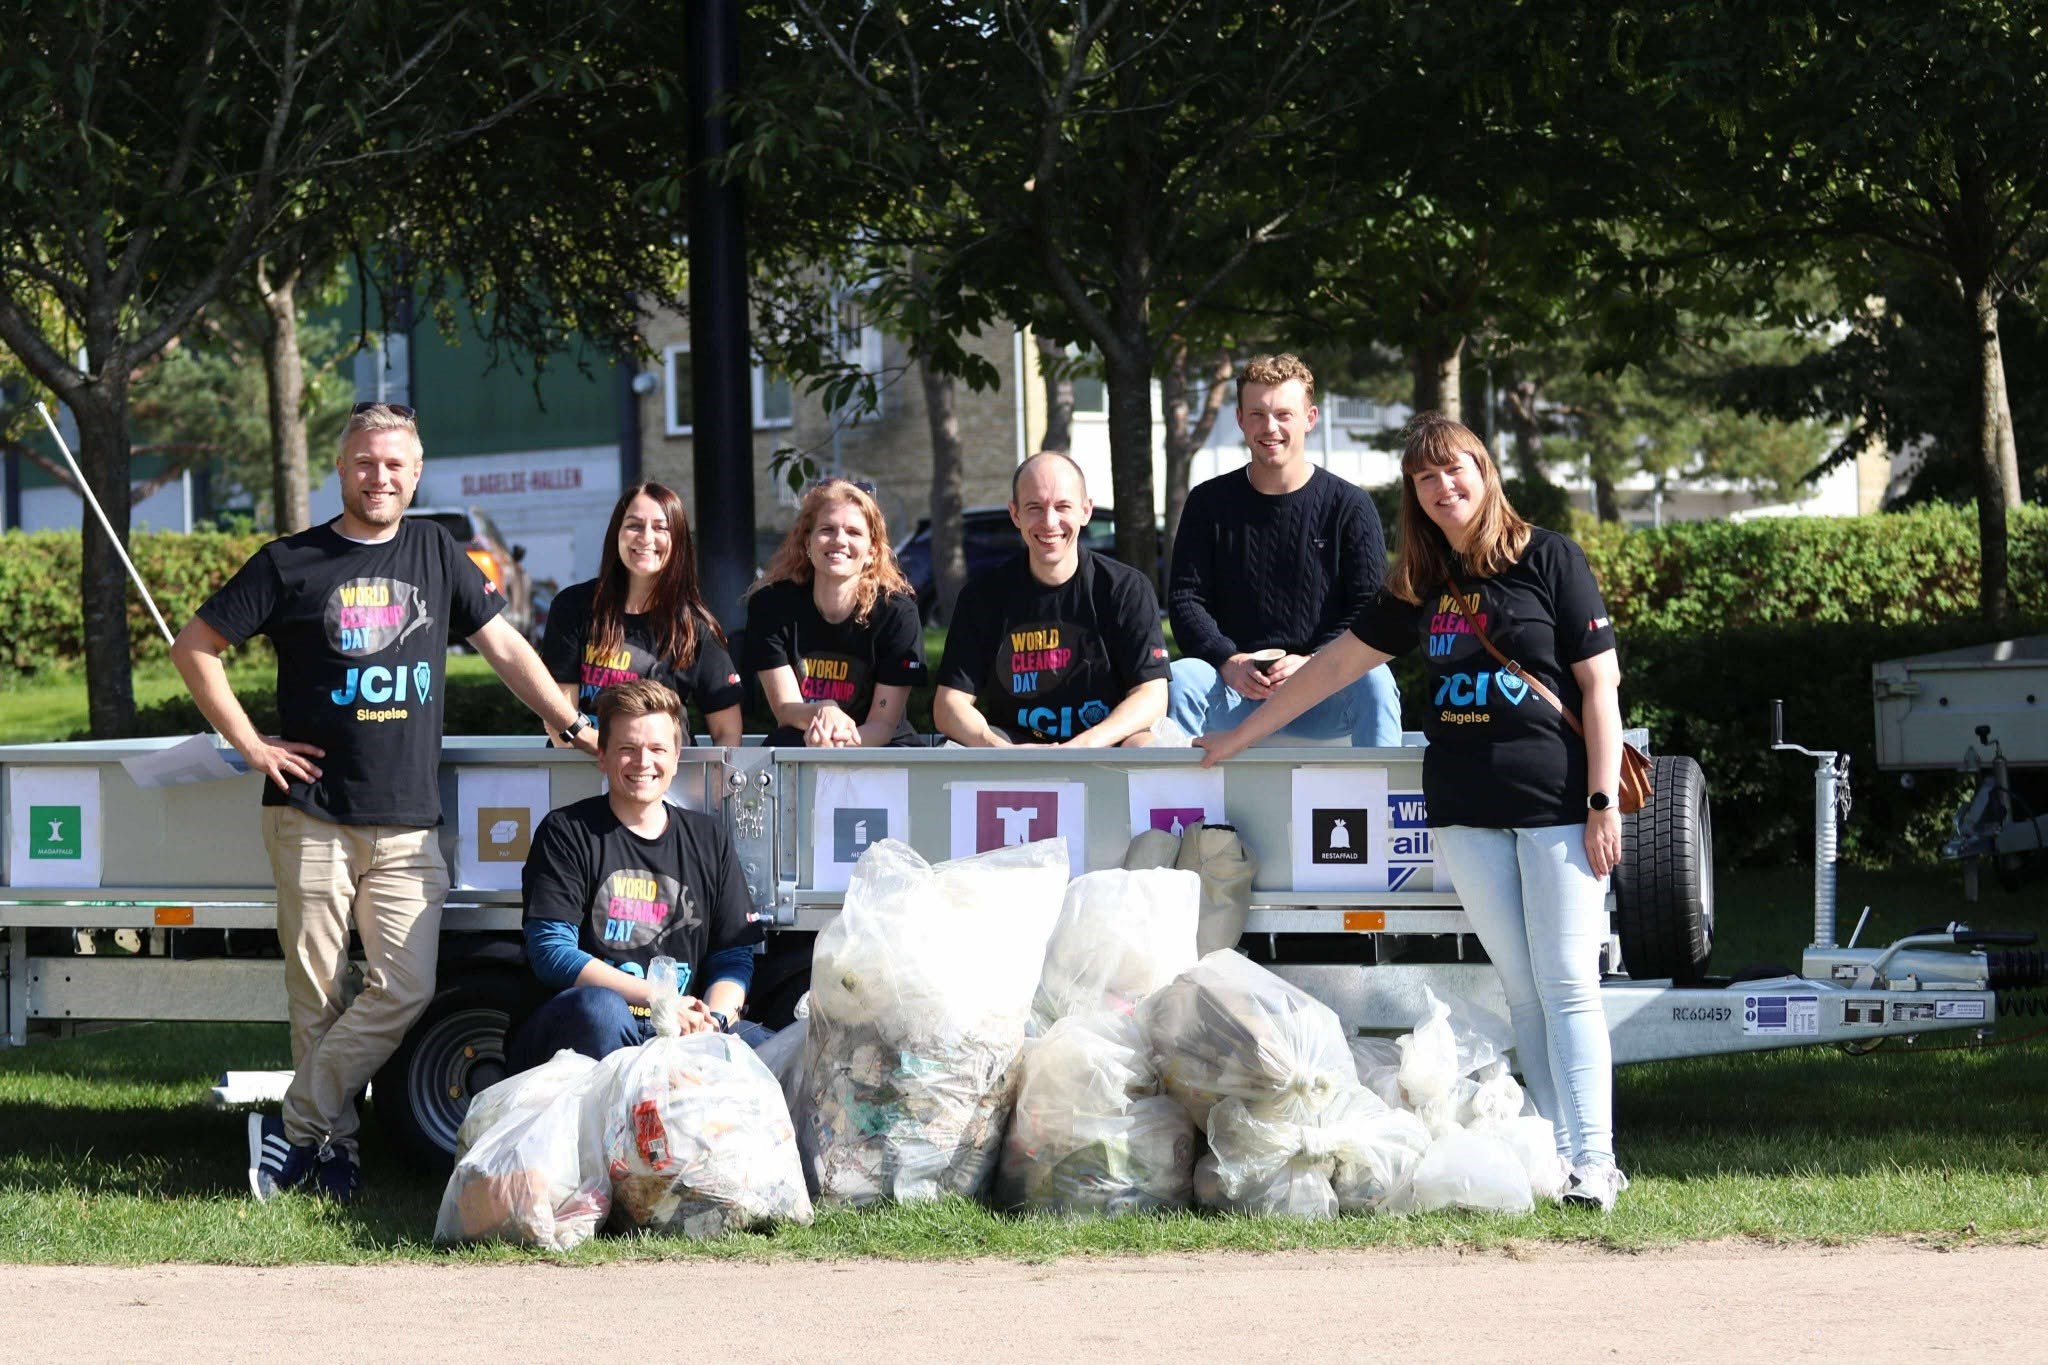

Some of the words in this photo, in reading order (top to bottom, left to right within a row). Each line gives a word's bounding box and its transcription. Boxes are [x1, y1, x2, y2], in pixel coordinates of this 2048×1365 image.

[340, 584, 389, 607] WORLD
[1438, 592, 1481, 615] WOLD
[340, 605, 403, 628] CLEANUP
[341, 627, 371, 651] DAY
[1011, 628, 1059, 652] WORLD
[1429, 633, 1455, 656] DAY
[805, 658, 848, 681] WORLD
[1012, 648, 1072, 673] CLEANUP
[331, 666, 408, 705] JCI
[801, 677, 856, 703] CLEANUP
[1013, 671, 1039, 693] DAY
[357, 707, 408, 722] Slagelse
[1440, 710, 1491, 725] Slagelse
[1321, 852, 1358, 860] RESTAFFALD
[612, 875, 657, 902] WORLD
[608, 896, 670, 926] CLEANUP
[604, 918, 636, 943] DAY
[1672, 1007, 1732, 1021] RC60459
